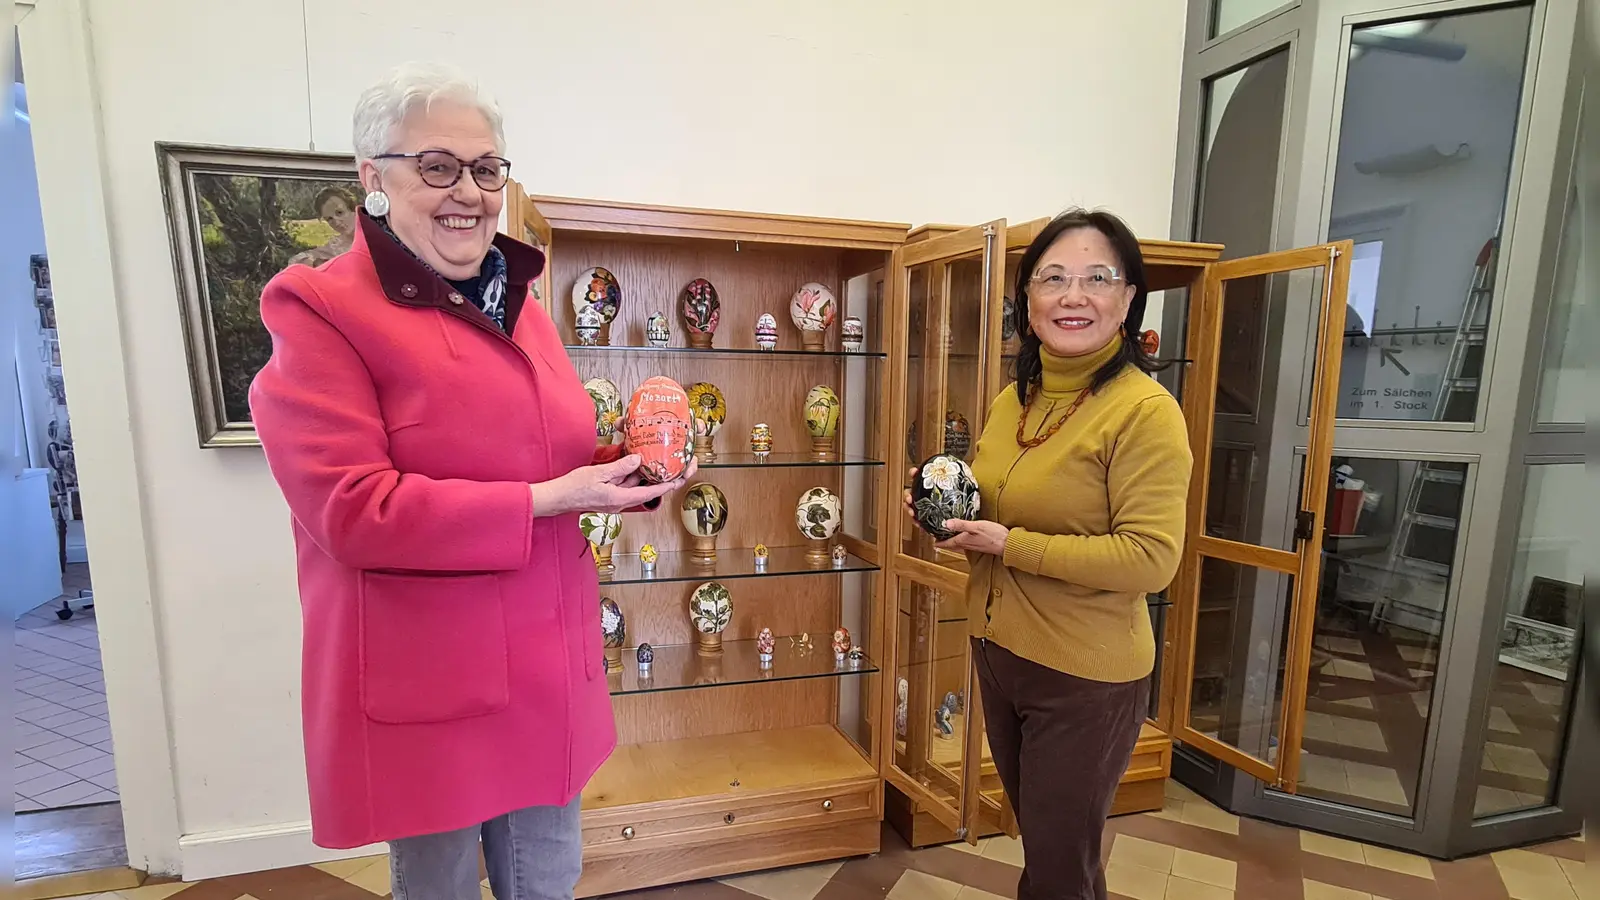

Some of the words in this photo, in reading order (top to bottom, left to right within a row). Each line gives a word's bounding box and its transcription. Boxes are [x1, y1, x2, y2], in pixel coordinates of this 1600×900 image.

[1351, 387, 1377, 396] Zum
[1383, 387, 1432, 397] Sälchen
[1350, 401, 1364, 409] im
[1374, 401, 1384, 409] 1.
[1394, 400, 1428, 410] Stock
